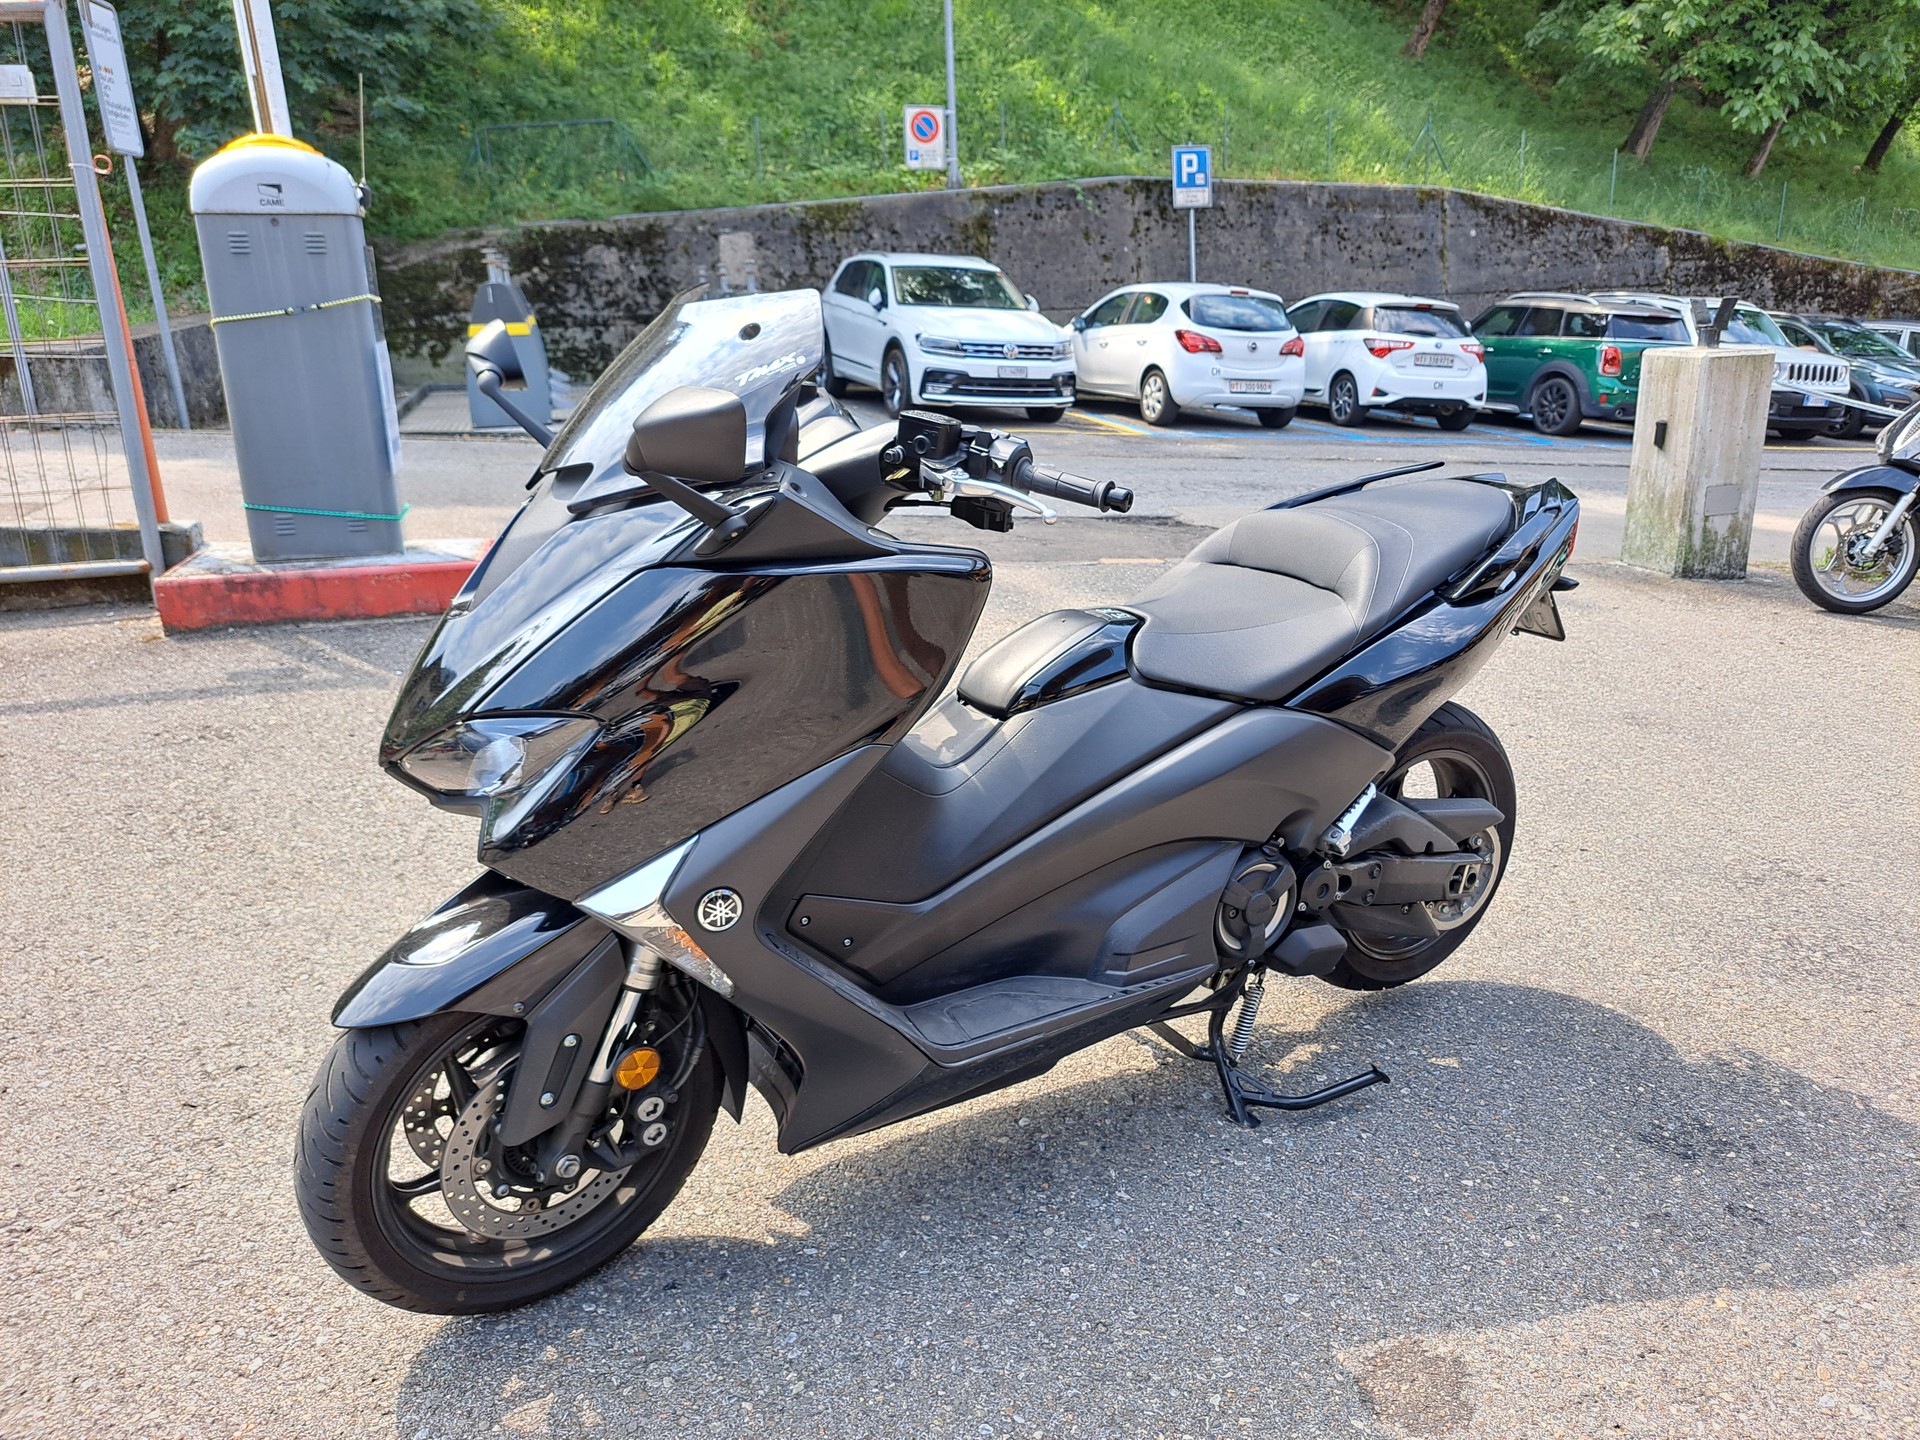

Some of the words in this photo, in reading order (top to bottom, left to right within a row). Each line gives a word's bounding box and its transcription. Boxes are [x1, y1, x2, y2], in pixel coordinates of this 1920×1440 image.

[1181, 153, 1198, 184] P
[260, 199, 285, 207] CAME
[1211, 367, 1221, 376] CH
[1433, 381, 1443, 390] CH
